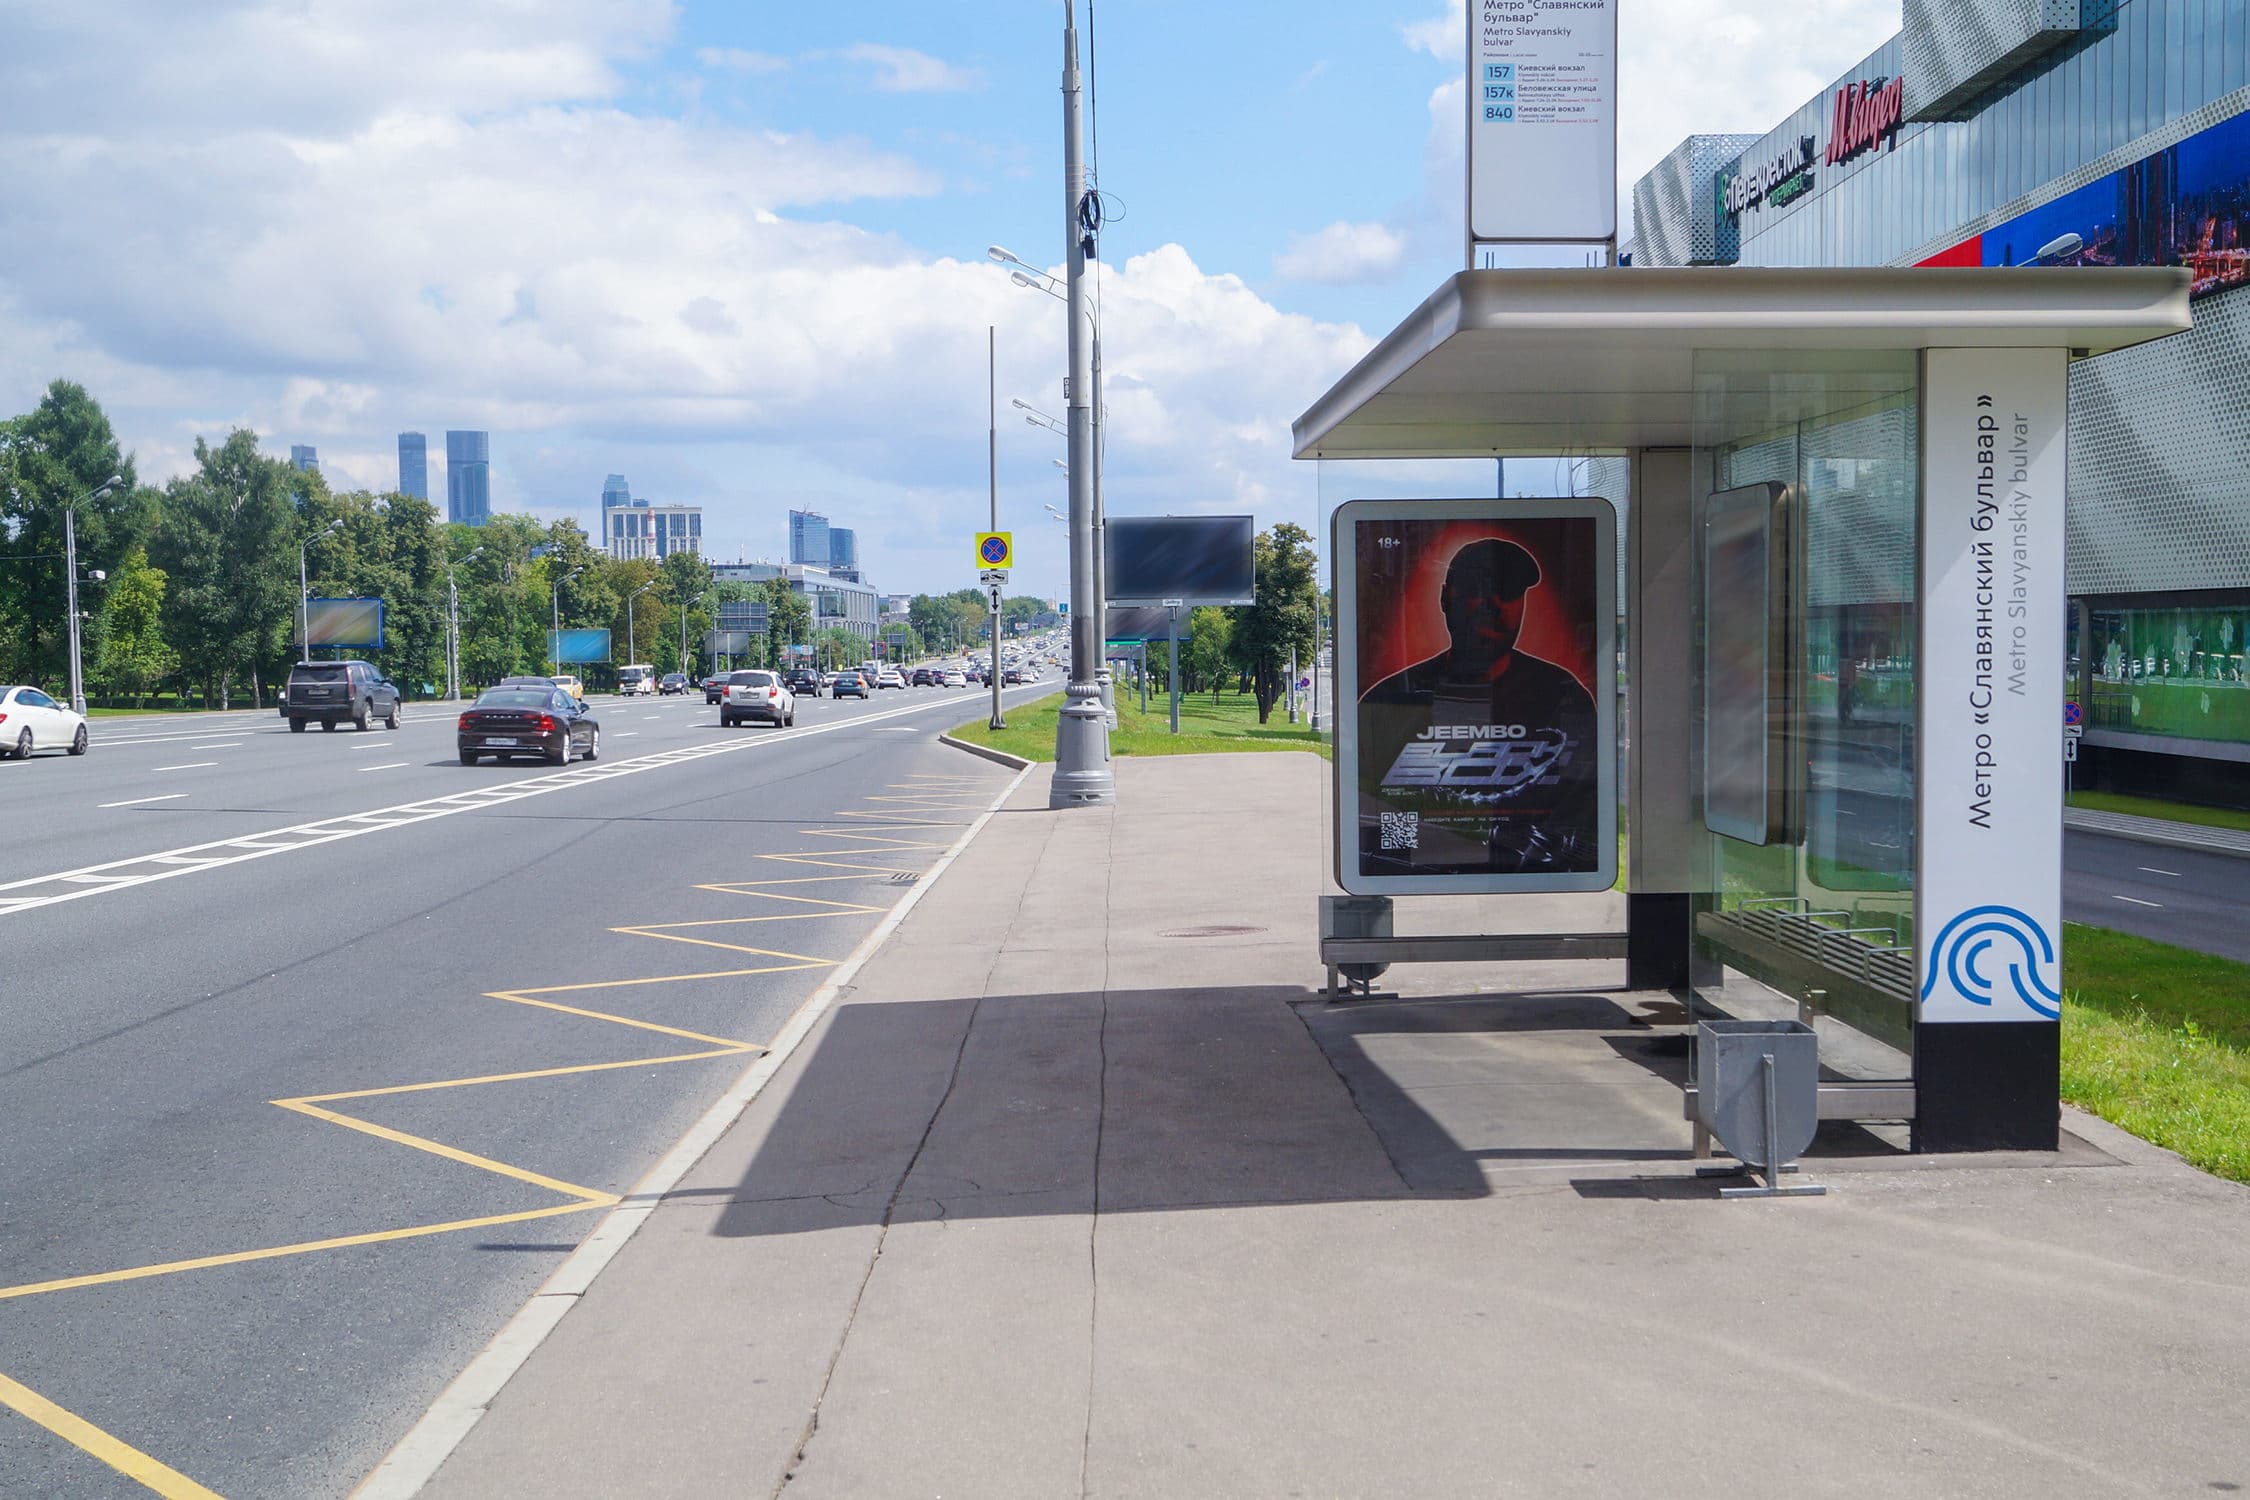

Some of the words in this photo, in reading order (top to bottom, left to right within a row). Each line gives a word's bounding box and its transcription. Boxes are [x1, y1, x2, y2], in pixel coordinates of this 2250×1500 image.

[1483, 0, 1525, 11] Метро
[1483, 12, 1539, 24] бульвар"
[1483, 27, 1514, 36] Metro
[1516, 27, 1572, 37] Slavyanskiy
[1483, 38, 1514, 46] bulvar
[1488, 66, 1510, 78] 157
[1518, 64, 1556, 72] Киевский
[1485, 86, 1514, 98] 157к
[1486, 107, 1512, 119] 840
[1518, 105, 1556, 113] Киевский
[2007, 412, 2028, 482] bulvar
[1970, 394, 2000, 532] бульвар»
[1377, 537, 1401, 549] 18+
[2007, 490, 2032, 619] Slavyanskiy
[1969, 541, 1994, 725] «Славянский
[2007, 625, 2027, 697] Metro
[1416, 724, 1527, 740] JEEMBO
[1968, 733, 1998, 829] Метро
